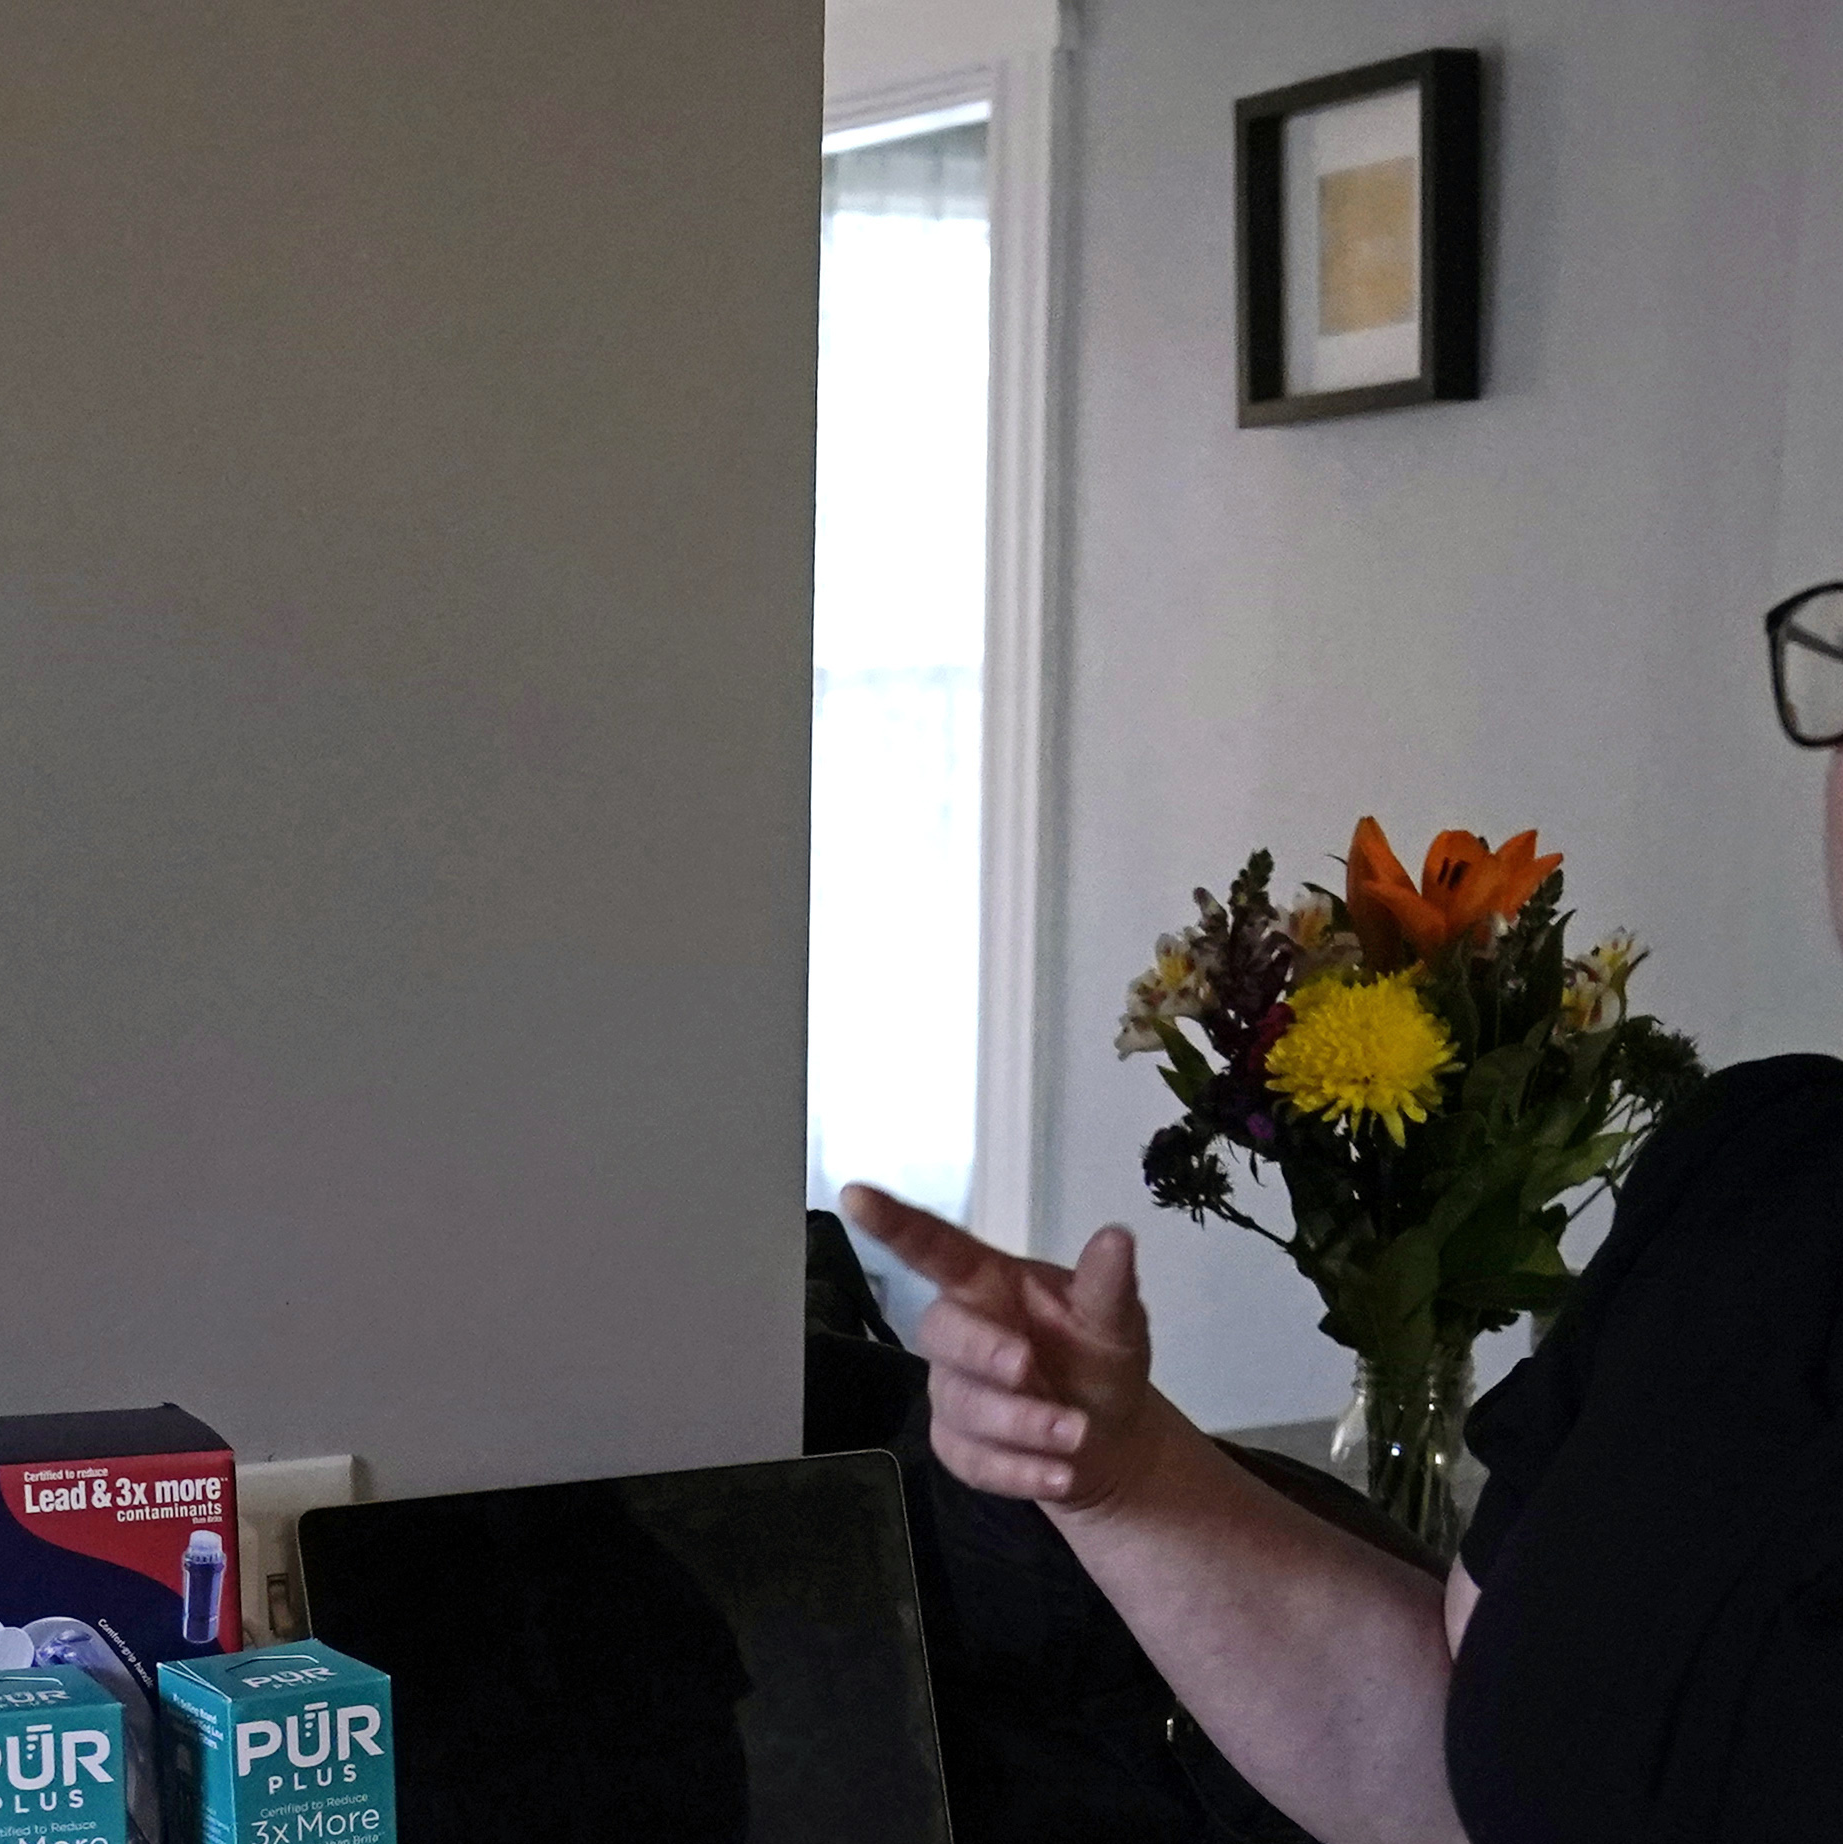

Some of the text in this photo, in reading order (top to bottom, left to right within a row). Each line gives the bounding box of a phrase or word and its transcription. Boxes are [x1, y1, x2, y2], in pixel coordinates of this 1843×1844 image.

[24, 1467, 108, 1483] Certified to reduce
[24, 1480, 86, 1513] Lead
[91, 1479, 112, 1509] &
[115, 1477, 148, 1507] 3x
[117, 1501, 222, 1522] contaminants
[268, 1764, 357, 1795] PLUS
[260, 1793, 368, 1819] Certified to Reduce
[34, 1824, 47, 1834] to
[51, 1820, 97, 1833] Reduce
[297, 1808, 380, 1841] More
